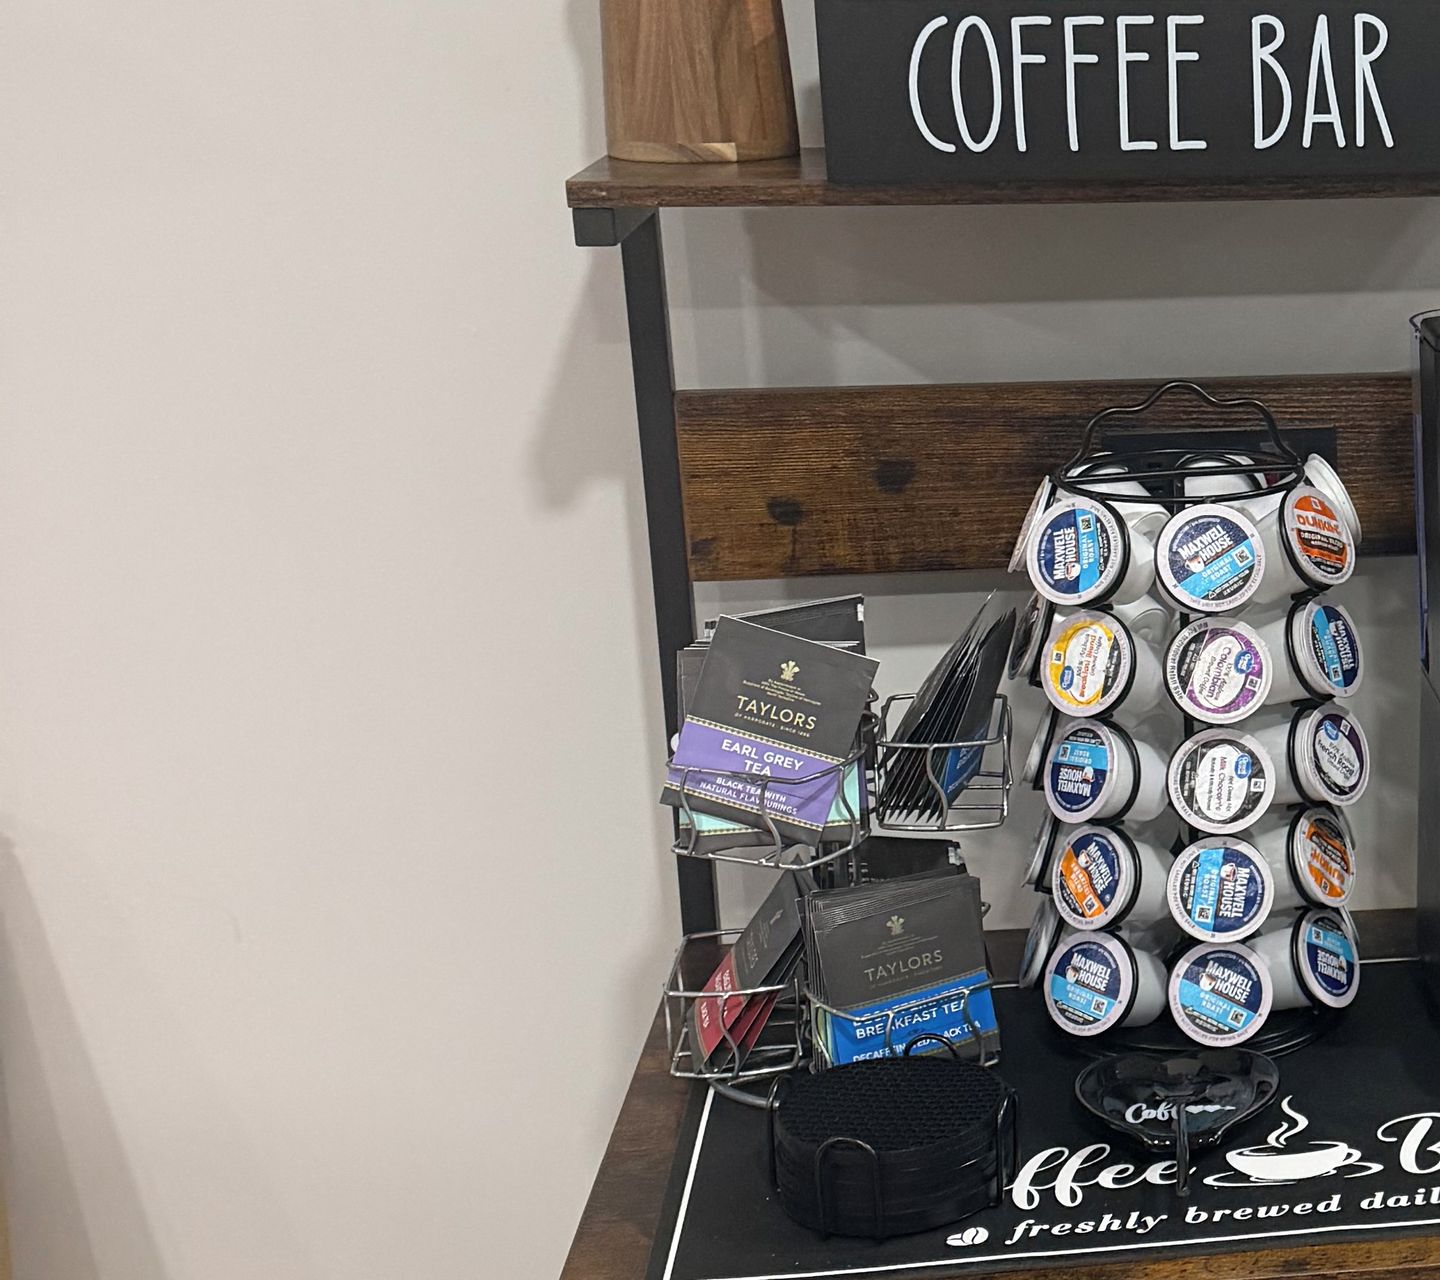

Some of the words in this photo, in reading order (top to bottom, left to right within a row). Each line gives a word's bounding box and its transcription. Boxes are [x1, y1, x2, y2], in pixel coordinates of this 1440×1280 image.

[907, 14, 1207, 153] COFFEE
[1251, 13, 1395, 150] BAR
[1052, 528, 1066, 580] MAXWELL
[1064, 526, 1077, 563] HOUSE
[1178, 524, 1227, 560] MAXWELL
[1199, 534, 1234, 561] HOUSE
[1336, 619, 1355, 670] MAXWELL
[1206, 646, 1232, 699] Colombian
[737, 695, 817, 730] TAYLORS
[721, 739, 759, 759] EARL
[763, 751, 804, 771] GREY
[744, 759, 772, 776] TEA
[716, 777, 744, 791] BLACK
[746, 785, 762, 795] TEA
[765, 790, 787, 802] WITH
[1057, 779, 1092, 797] MAXWELL
[1059, 767, 1083, 781] HOUSE
[700, 782, 738, 798] NATURAL
[739, 792, 799, 815] FLAVURINGS
[1087, 841, 1113, 887] MAXWELL
[1088, 861, 1106, 895] HOUSE
[1219, 880, 1235, 918] HOUSE
[1231, 867, 1250, 918] MAXWELL
[863, 949, 943, 982] TAYLORS
[1071, 952, 1112, 980] MAXWELL
[1078, 970, 1109, 992] HOUSE
[1205, 959, 1253, 992] MAXWELL
[1214, 978, 1250, 1003] HOUSE
[855, 1007, 938, 1039] BREKFAST
[1002, 1142, 1196, 1211] ffee
[1004, 1210, 1168, 1248] freshly
[1184, 1192, 1342, 1224] brewed
